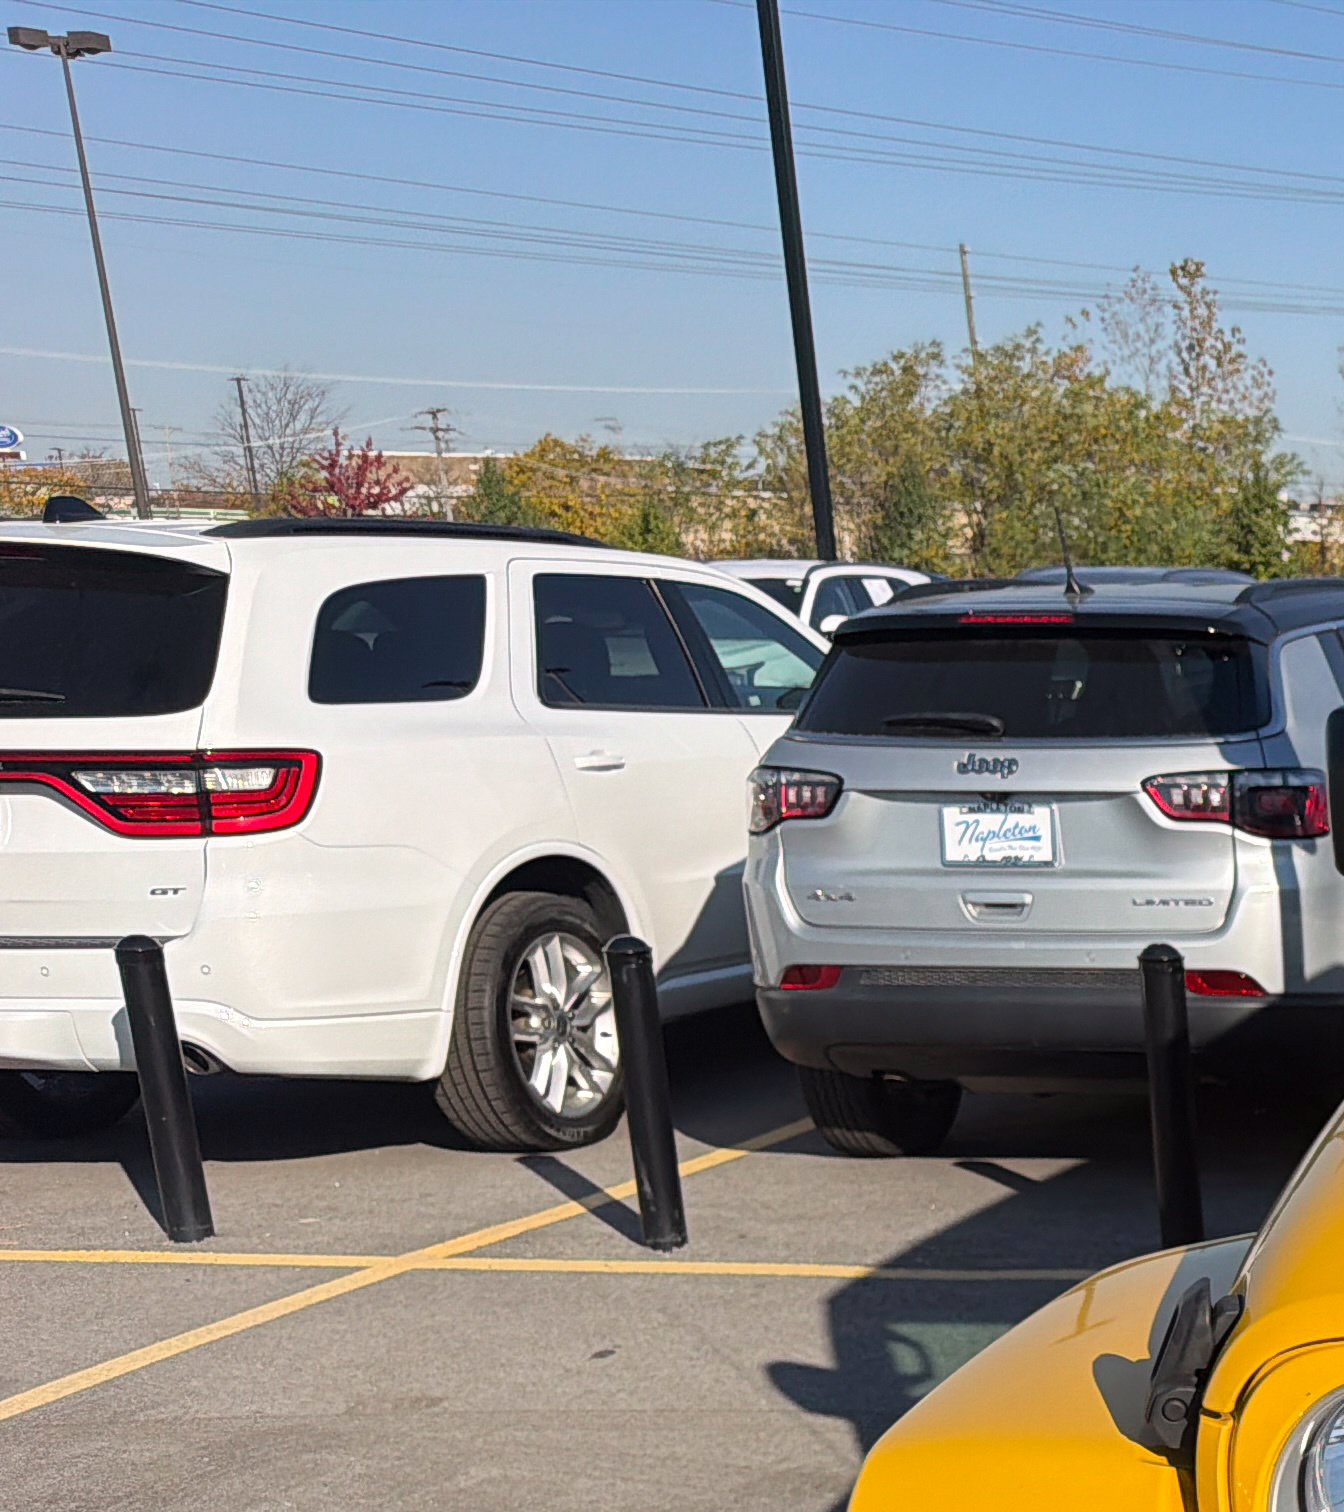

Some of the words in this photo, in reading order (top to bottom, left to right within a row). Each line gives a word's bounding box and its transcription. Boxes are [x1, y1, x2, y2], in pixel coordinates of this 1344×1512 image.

[956, 752, 1019, 779] Jeep
[955, 812, 1040, 855] Napleton
[149, 887, 187, 896] GT
[1132, 898, 1214, 907] LIMITED
